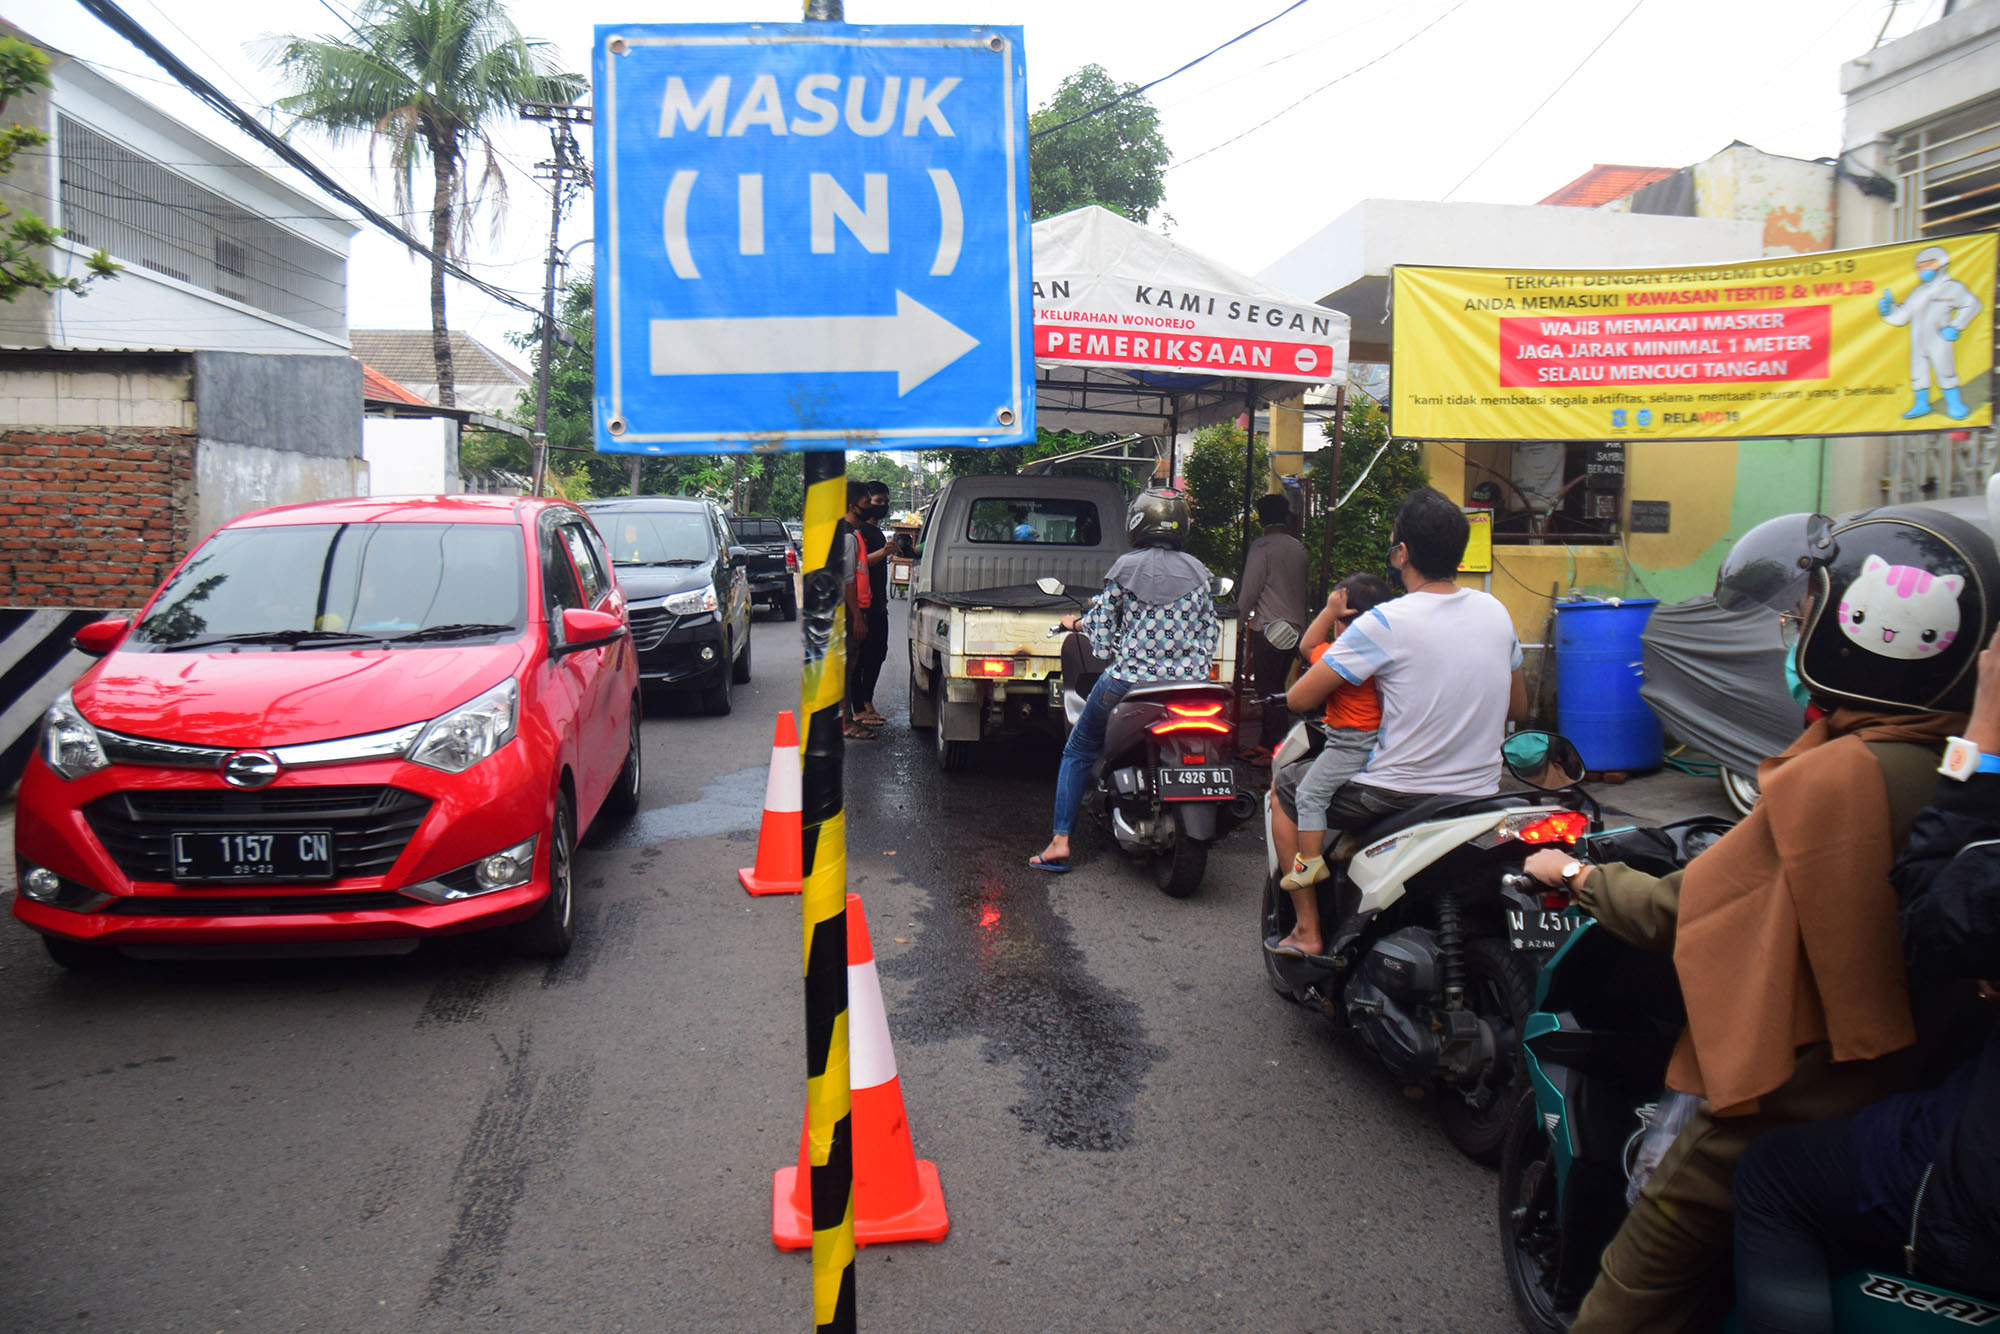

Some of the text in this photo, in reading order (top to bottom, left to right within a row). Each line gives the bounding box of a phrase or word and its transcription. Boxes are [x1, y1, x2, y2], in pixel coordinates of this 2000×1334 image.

[658, 74, 963, 138] MASUK
[1504, 259, 1856, 289] TERKAIT DENGAN PANDEMI COVID-19
[1464, 280, 1874, 311] ANDA MEMASUKI KAWASAN TERTIB & WAJIB
[1040, 309, 1118, 324] KELURAHAN
[1122, 313, 1195, 329] WONOREJO
[1135, 285, 1215, 315] KAMI
[1228, 301, 1331, 336] SEGAN
[1540, 313, 1784, 336] WAJIB MEMAKAI MASKER
[1048, 331, 1272, 367] PEMERIKSAAN
[1516, 335, 1812, 359] JAGA JARAK MINIMAL 1 METER
[1538, 360, 1788, 382] SELALU MENCUCI TANGAN
[1446, 395, 1477, 405] tidak
[1481, 394, 1546, 405] membatasi
[1550, 394, 1590, 408] segala
[1649, 392, 1694, 403] selama
[1698, 390, 1756, 402] mentaati
[1760, 389, 1801, 400] aturan
[1807, 388, 1840, 400] yang
[1164, 771, 1229, 784] L 4926 DL
[176, 834, 328, 863] L 1157 CN
[1510, 911, 1524, 931] W
